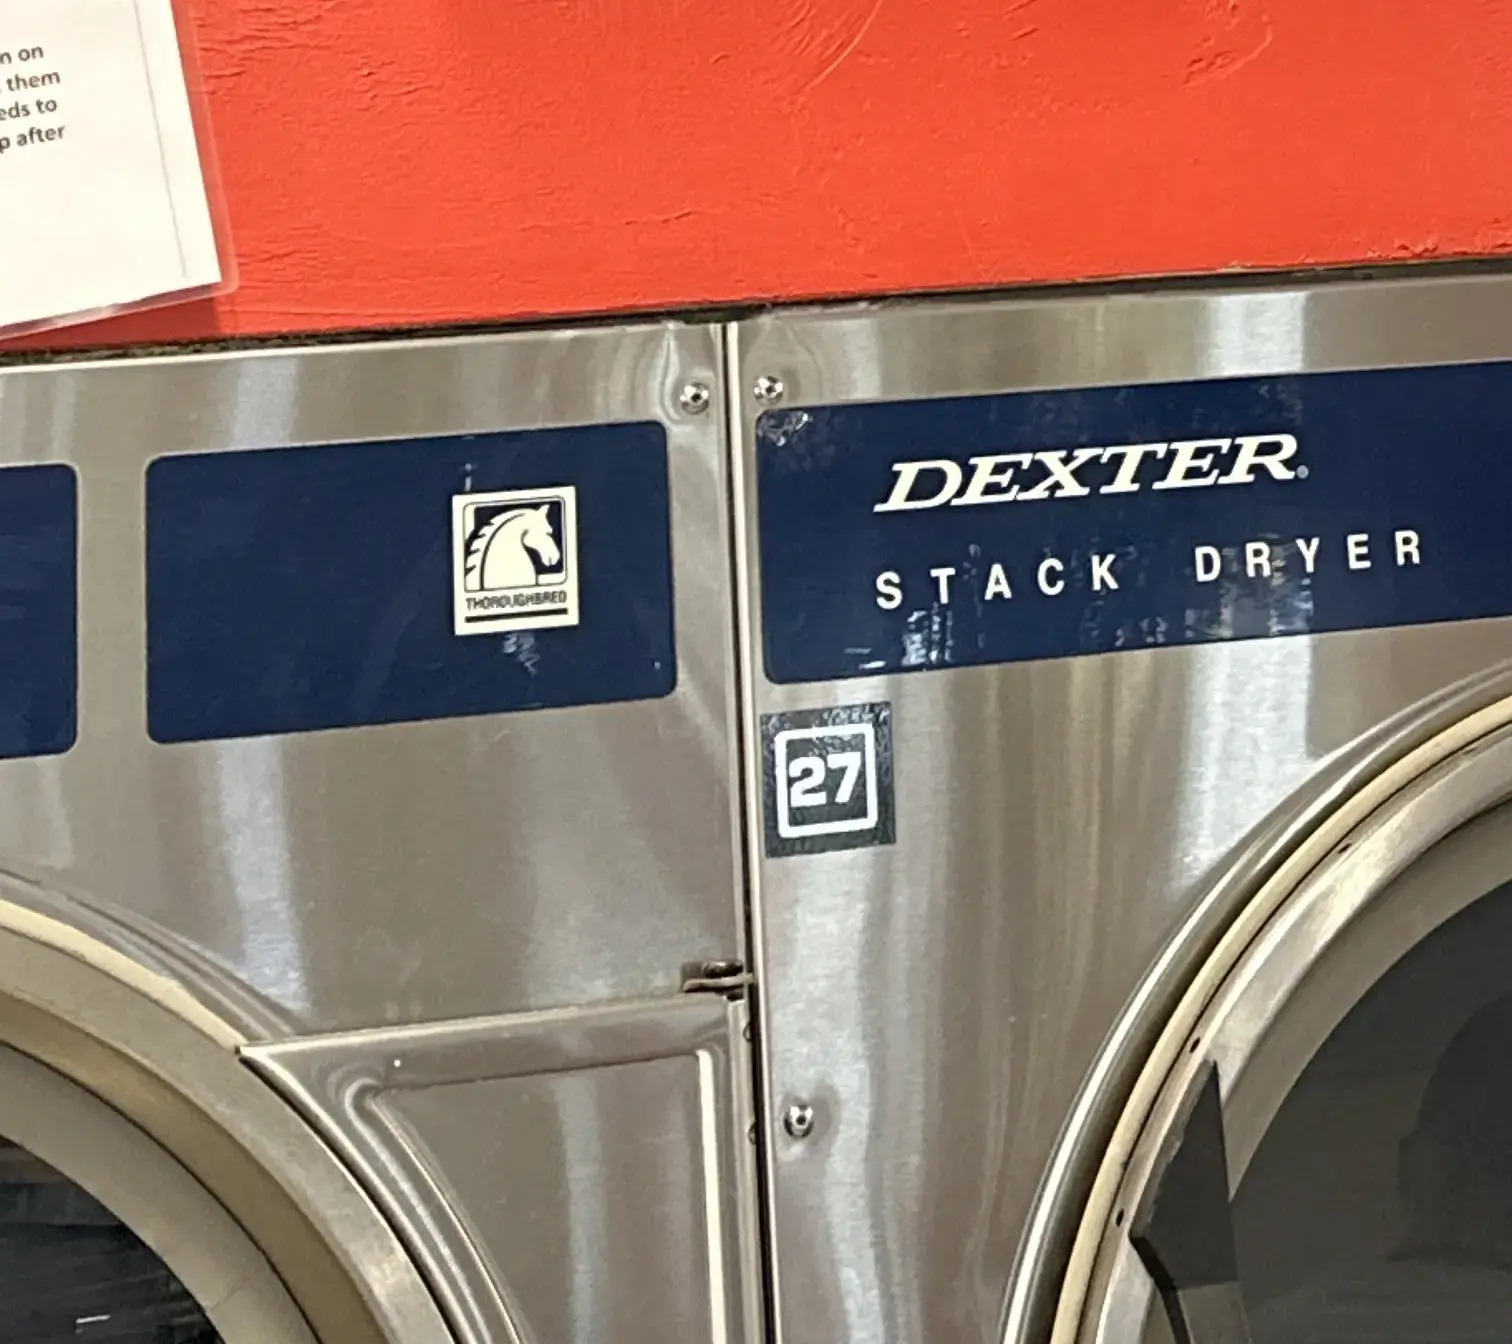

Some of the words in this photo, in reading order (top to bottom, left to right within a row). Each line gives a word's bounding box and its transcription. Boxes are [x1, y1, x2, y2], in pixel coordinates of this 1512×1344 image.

[18, 46, 44, 62] on
[6, 72, 61, 92] them
[36, 98, 57, 114] to
[16, 124, 66, 147] after
[873, 433, 1299, 513] DEXTER
[875, 553, 1119, 611] STACK
[1193, 529, 1422, 584] DRYER
[788, 751, 862, 808] 27
